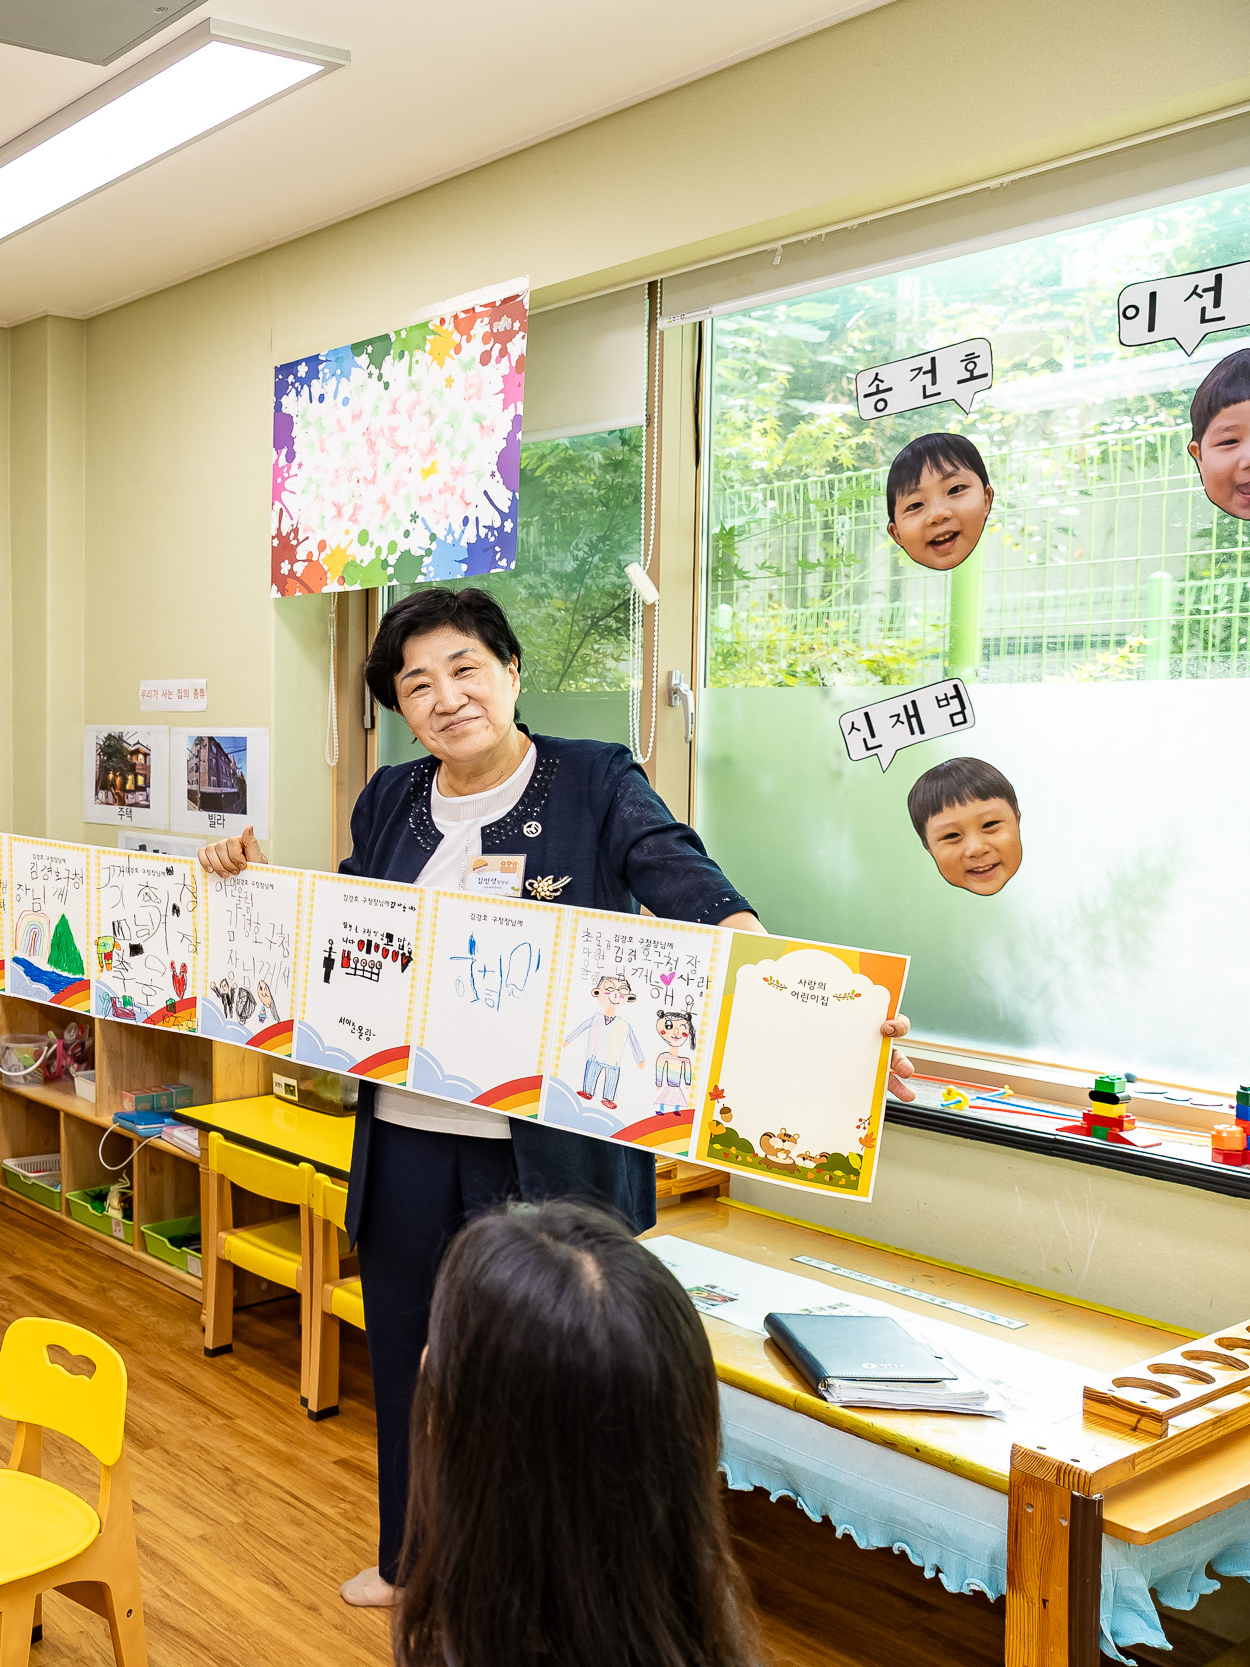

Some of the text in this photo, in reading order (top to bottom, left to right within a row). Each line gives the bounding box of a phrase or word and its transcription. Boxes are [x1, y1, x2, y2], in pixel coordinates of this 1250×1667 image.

[141, 689, 159, 700] 우리가
[161, 688, 174, 700] 사는
[176, 688, 190, 700] 집의
[848, 683, 968, 751] 신재범
[117, 806, 133, 822] 주택
[207, 812, 226, 829] 빌라
[469, 912, 488, 922] 김경호
[613, 934, 674, 950] 김경호 구청장님께
[797, 978, 827, 991] 사랑의
[790, 990, 830, 1006] 어린이집
